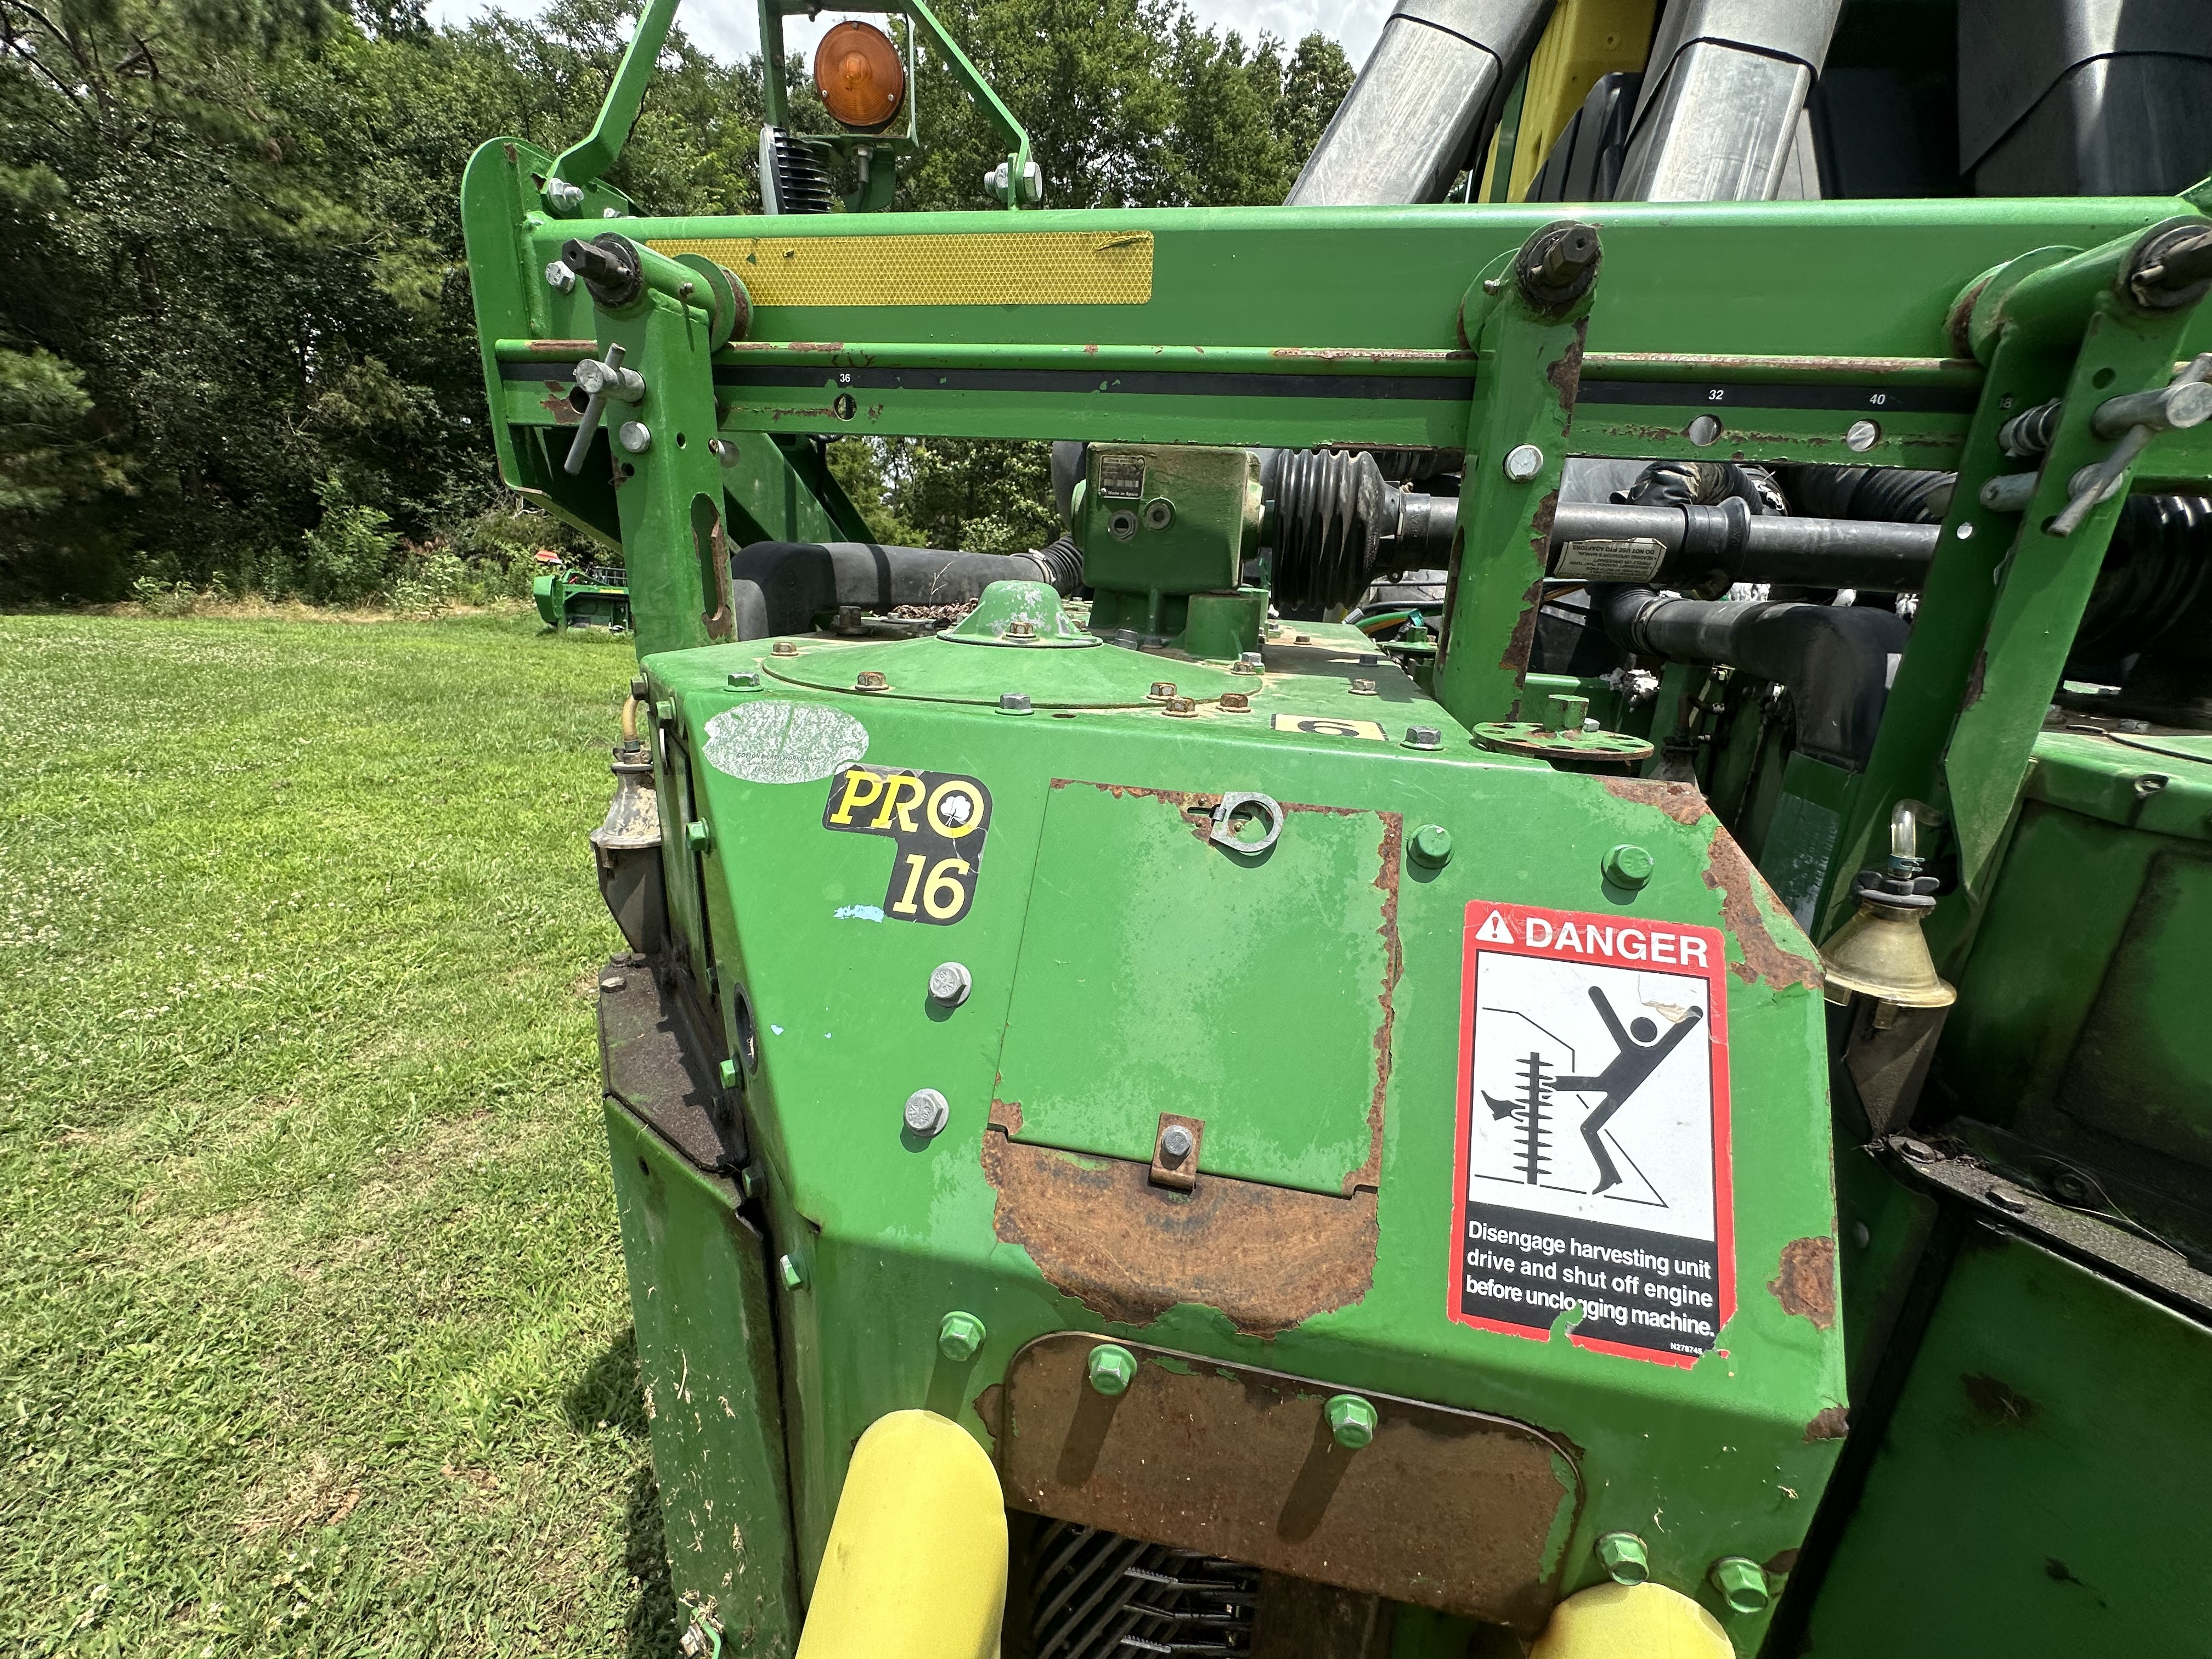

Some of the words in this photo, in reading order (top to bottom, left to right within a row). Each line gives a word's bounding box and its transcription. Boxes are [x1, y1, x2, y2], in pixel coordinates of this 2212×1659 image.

[840, 373, 851, 383] 36
[1708, 389, 1724, 400] 32
[1869, 393, 1886, 405] 40
[1297, 720, 1359, 737] 6
[830, 770, 984, 838] PRO
[892, 854, 970, 919] 16
[1525, 917, 1709, 968] DANGER
[1469, 1220, 1566, 1256] Disengage
[1570, 1237, 1669, 1276] harvesting
[1674, 1260, 1712, 1280] unit
[1466, 1249, 1516, 1272] drive
[1520, 1259, 1557, 1280] and
[1562, 1267, 1607, 1290] shut
[1612, 1276, 1639, 1295] off
[1644, 1282, 1713, 1308] engine
[1466, 1275, 1523, 1302] before
[1631, 1308, 1715, 1337] machine.
